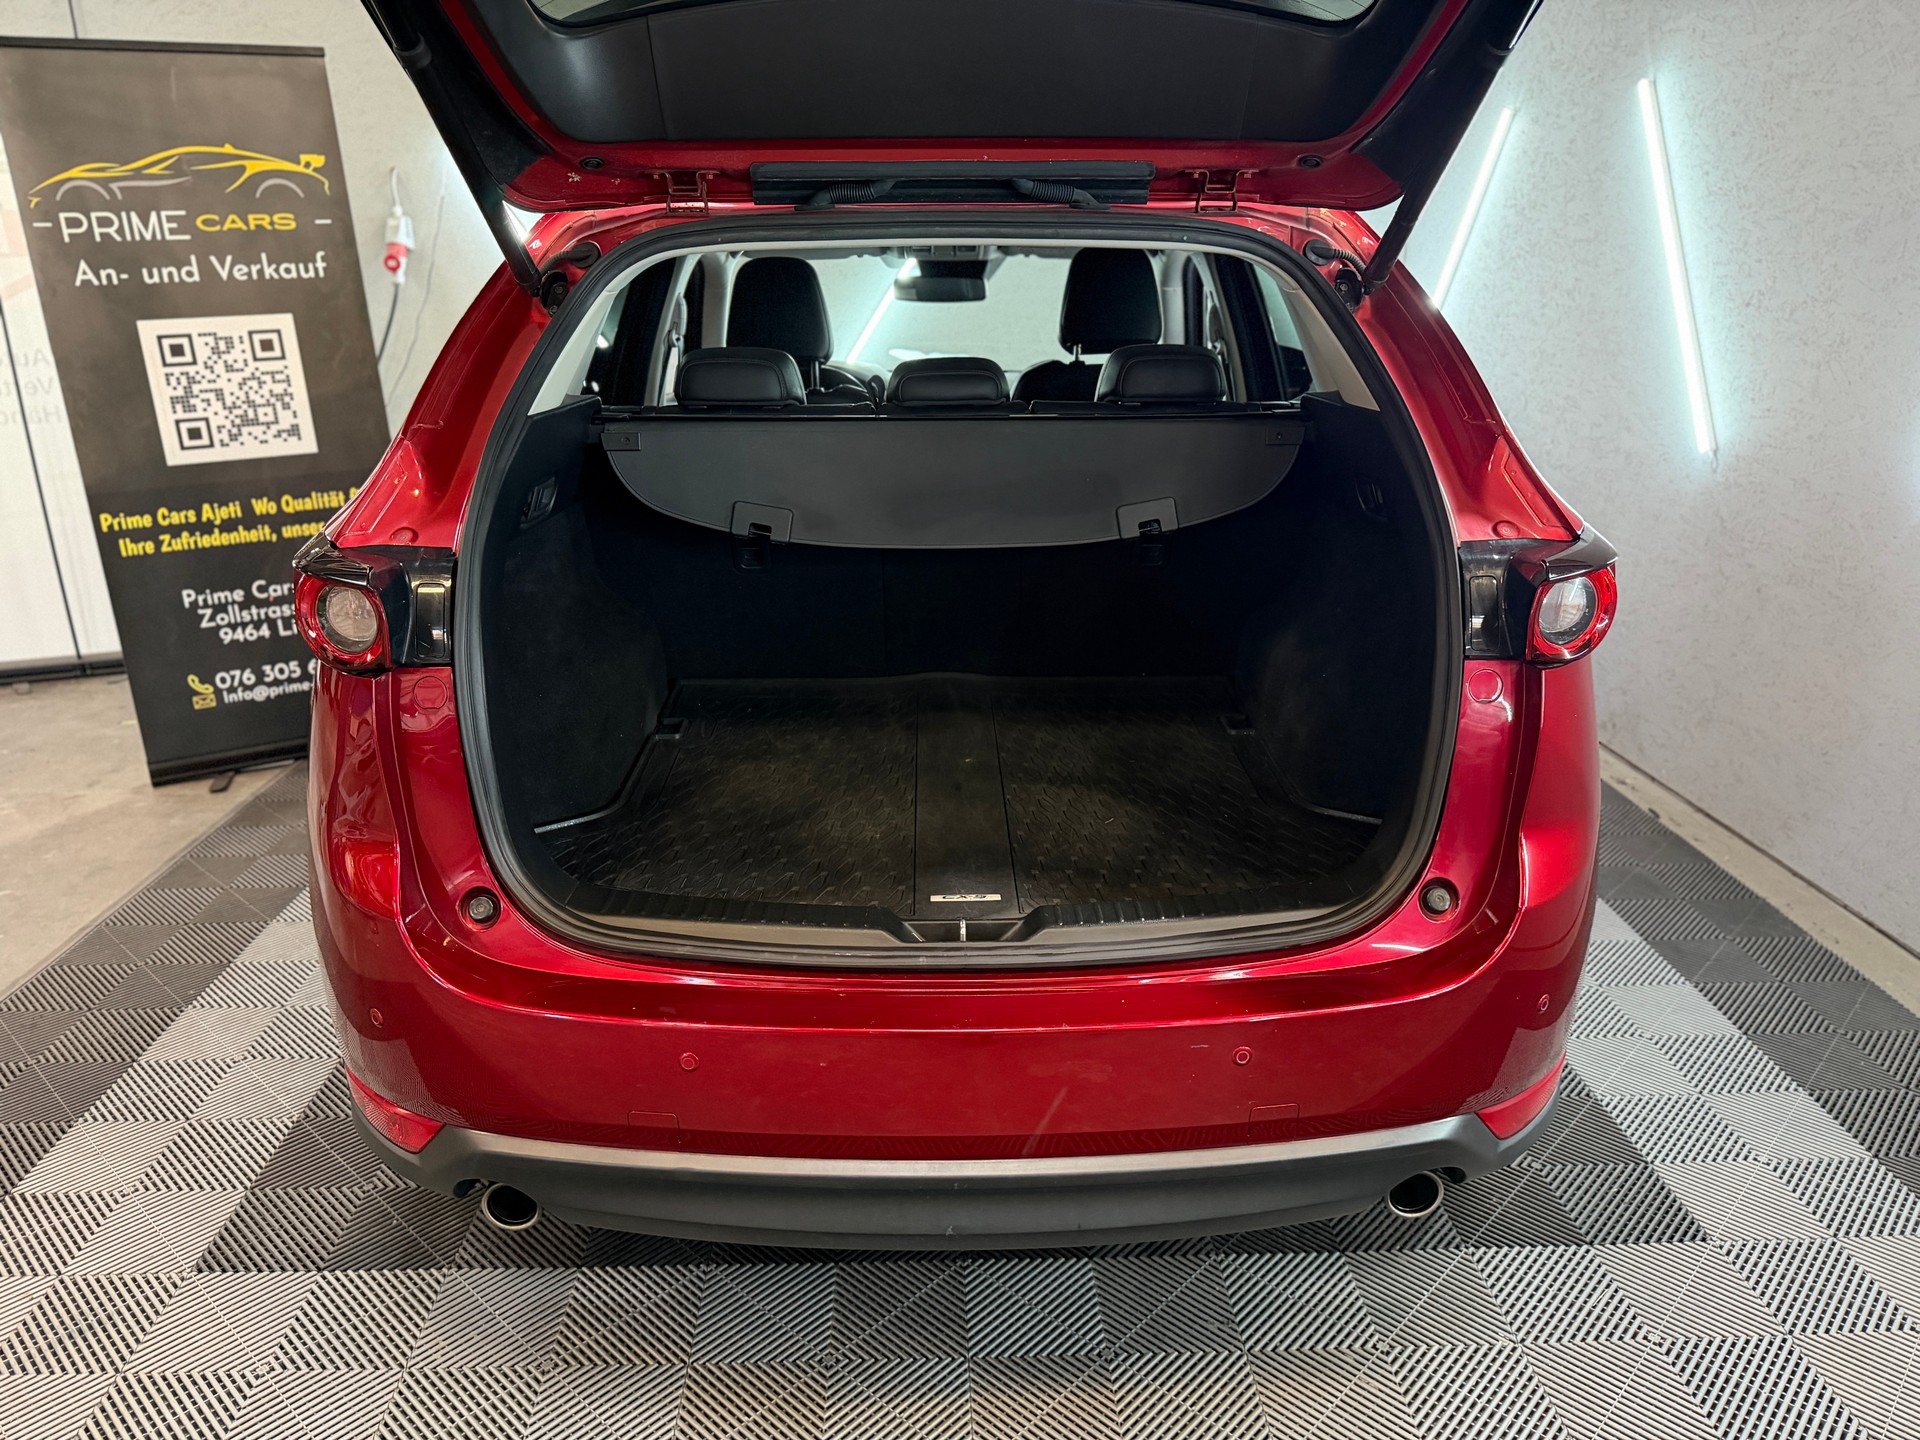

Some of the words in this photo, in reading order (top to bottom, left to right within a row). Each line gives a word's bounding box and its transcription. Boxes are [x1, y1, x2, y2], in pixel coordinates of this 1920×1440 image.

[58, 209, 192, 243] PRIME
[195, 212, 297, 232] CARS
[74, 259, 130, 287] An-
[142, 254, 201, 285] und
[209, 251, 328, 282] Verkauf
[99, 512, 153, 533] Prime
[156, 506, 198, 527] Cars
[201, 500, 243, 526] Ajeti
[251, 496, 278, 516] Wo
[280, 490, 346, 514] Qualität
[118, 537, 156, 558] Ihre
[158, 524, 278, 553] Zufriedenheit,
[181, 588, 246, 609] Prime
[251, 579, 295, 599] Car
[219, 622, 272, 645] 9464
[215, 667, 257, 690] 076
[261, 660, 302, 683] 305
